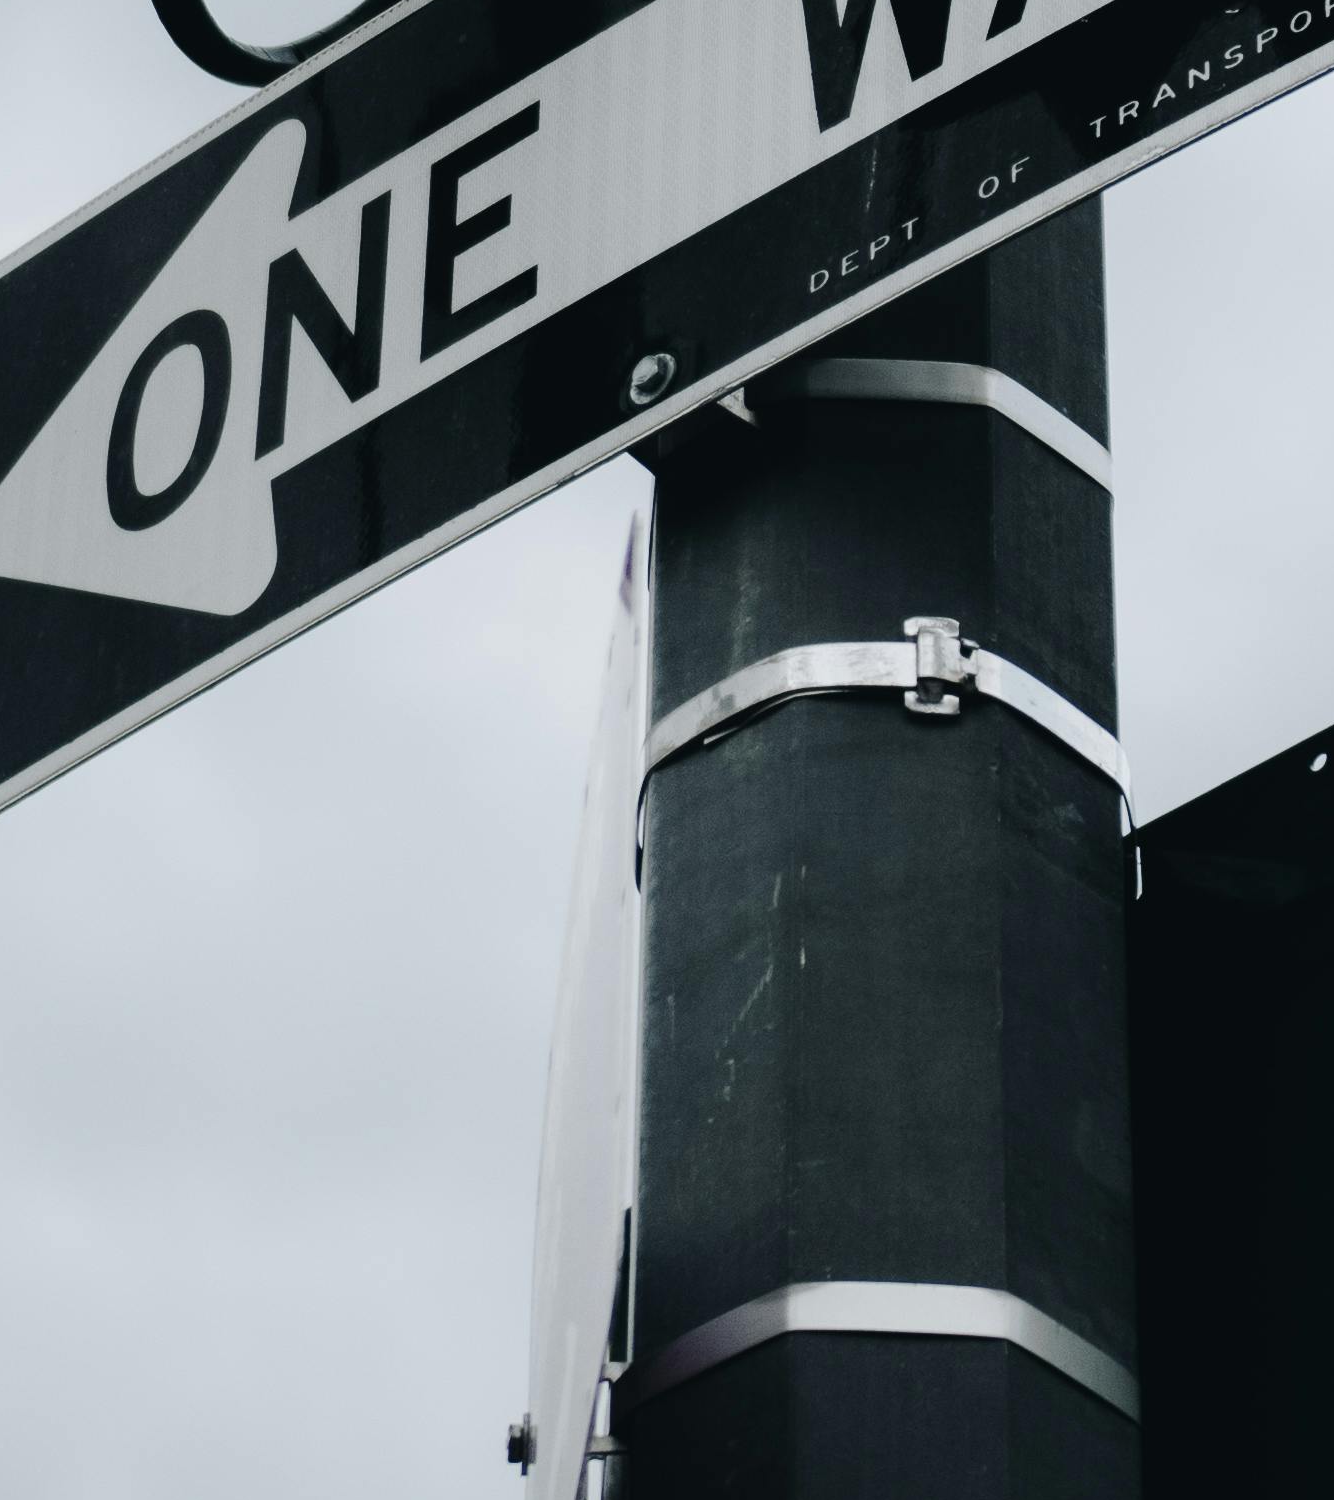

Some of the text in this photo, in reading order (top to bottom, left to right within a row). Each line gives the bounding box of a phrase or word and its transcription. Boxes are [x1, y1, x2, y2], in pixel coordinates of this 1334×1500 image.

[105, 98, 540, 532] ONE
[808, 217, 921, 295] DEPT
[977, 156, 1031, 200] OF
